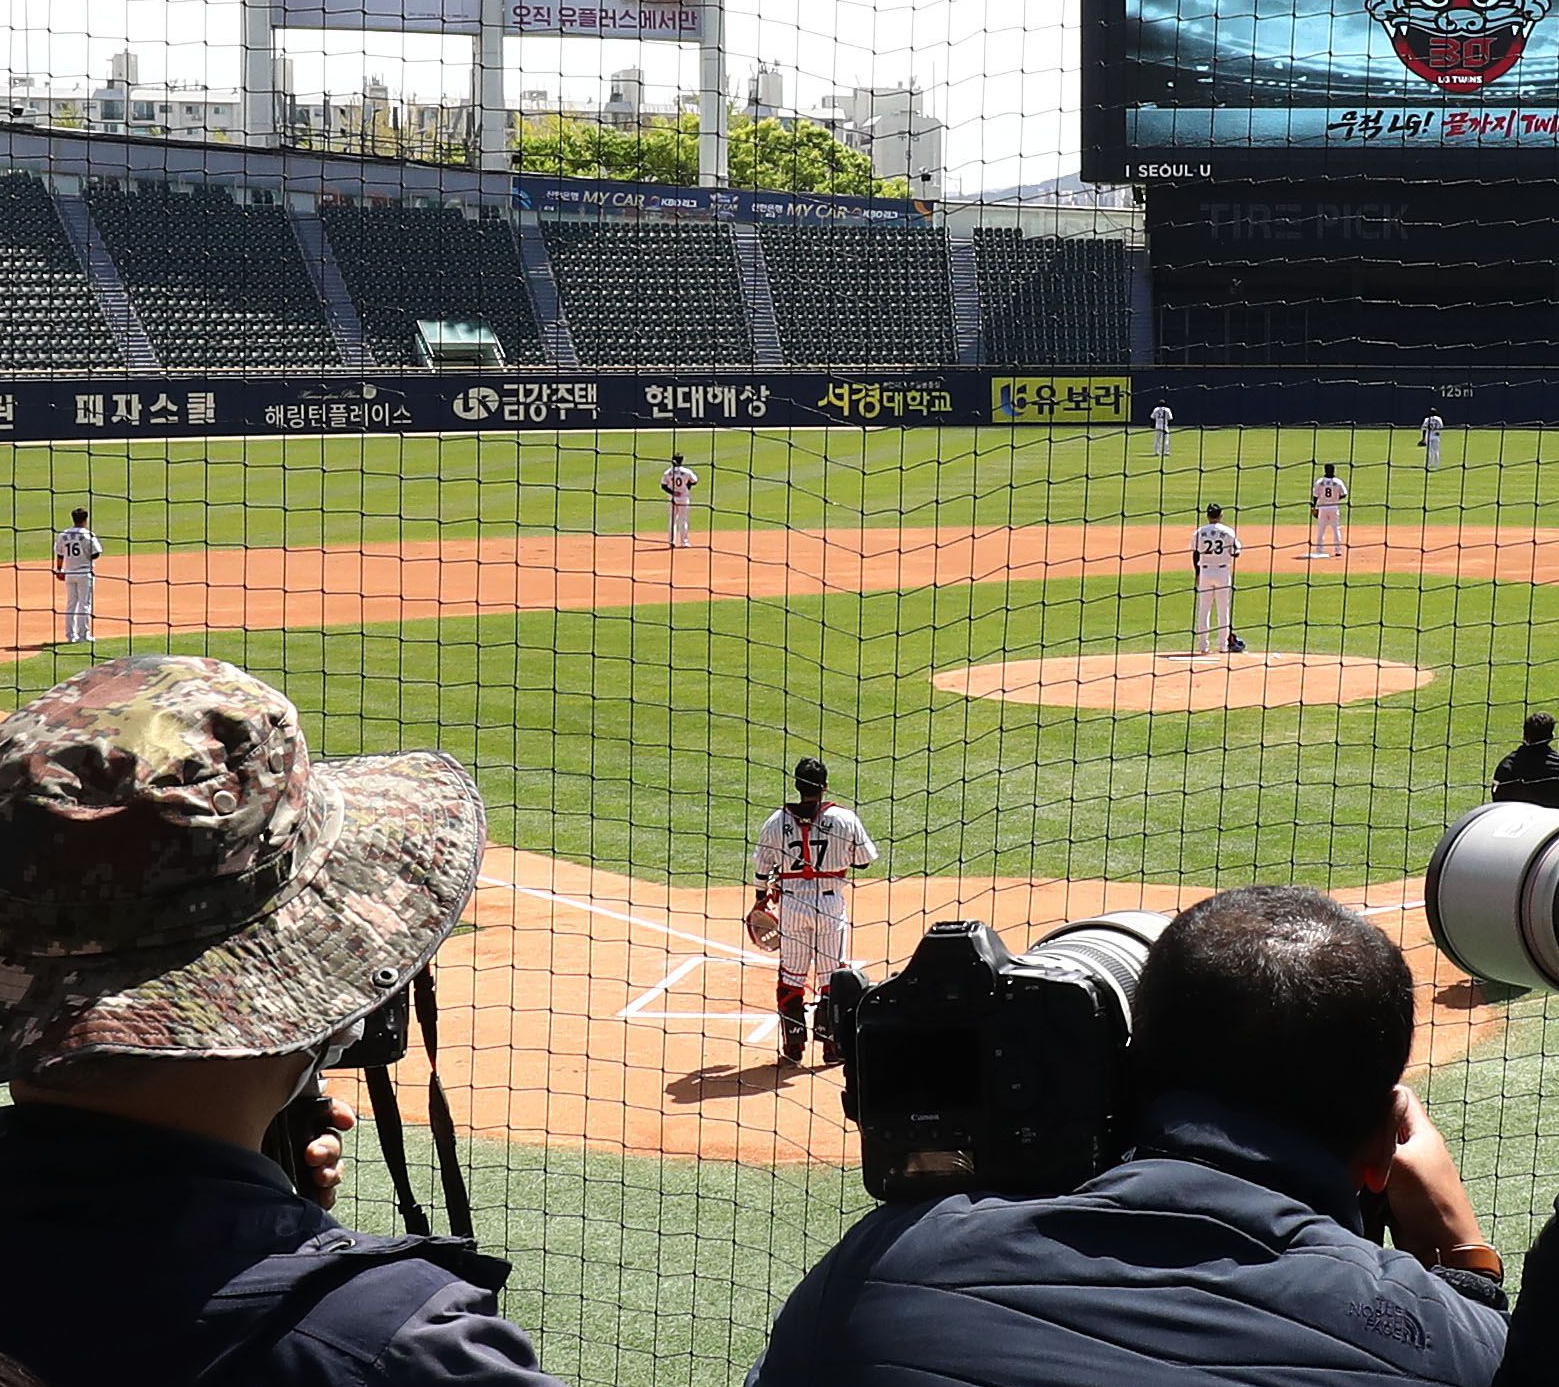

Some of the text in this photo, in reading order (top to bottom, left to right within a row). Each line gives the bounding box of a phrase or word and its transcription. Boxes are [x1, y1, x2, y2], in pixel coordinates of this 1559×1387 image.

[511, 5, 698, 31] 오직 유플러스에서만
[1437, 75, 1482, 84] LG TWINS
[1327, 109, 1385, 141] 무적
[1386, 110, 1435, 137] LG!
[1441, 110, 1517, 139] 끝까지
[582, 190, 610, 206] MY
[612, 192, 646, 208] CAR
[660, 198, 681, 208] KBO
[786, 203, 814, 218] MY
[815, 204, 849, 219] CAR
[74, 390, 218, 426] 피자스쿨
[502, 382, 599, 422] 금강주택
[644, 383, 771, 419] 현대해상
[817, 381, 953, 419] 서경대학교
[1030, 383, 1124, 415] 유보라
[264, 402, 413, 430] 해링턴플레이스
[1324, 487, 1332, 498] 8
[65, 542, 81, 557] 16
[1203, 539, 1224, 555] 23
[788, 839, 829, 872] 27
[910, 1112, 940, 1123] Canon
